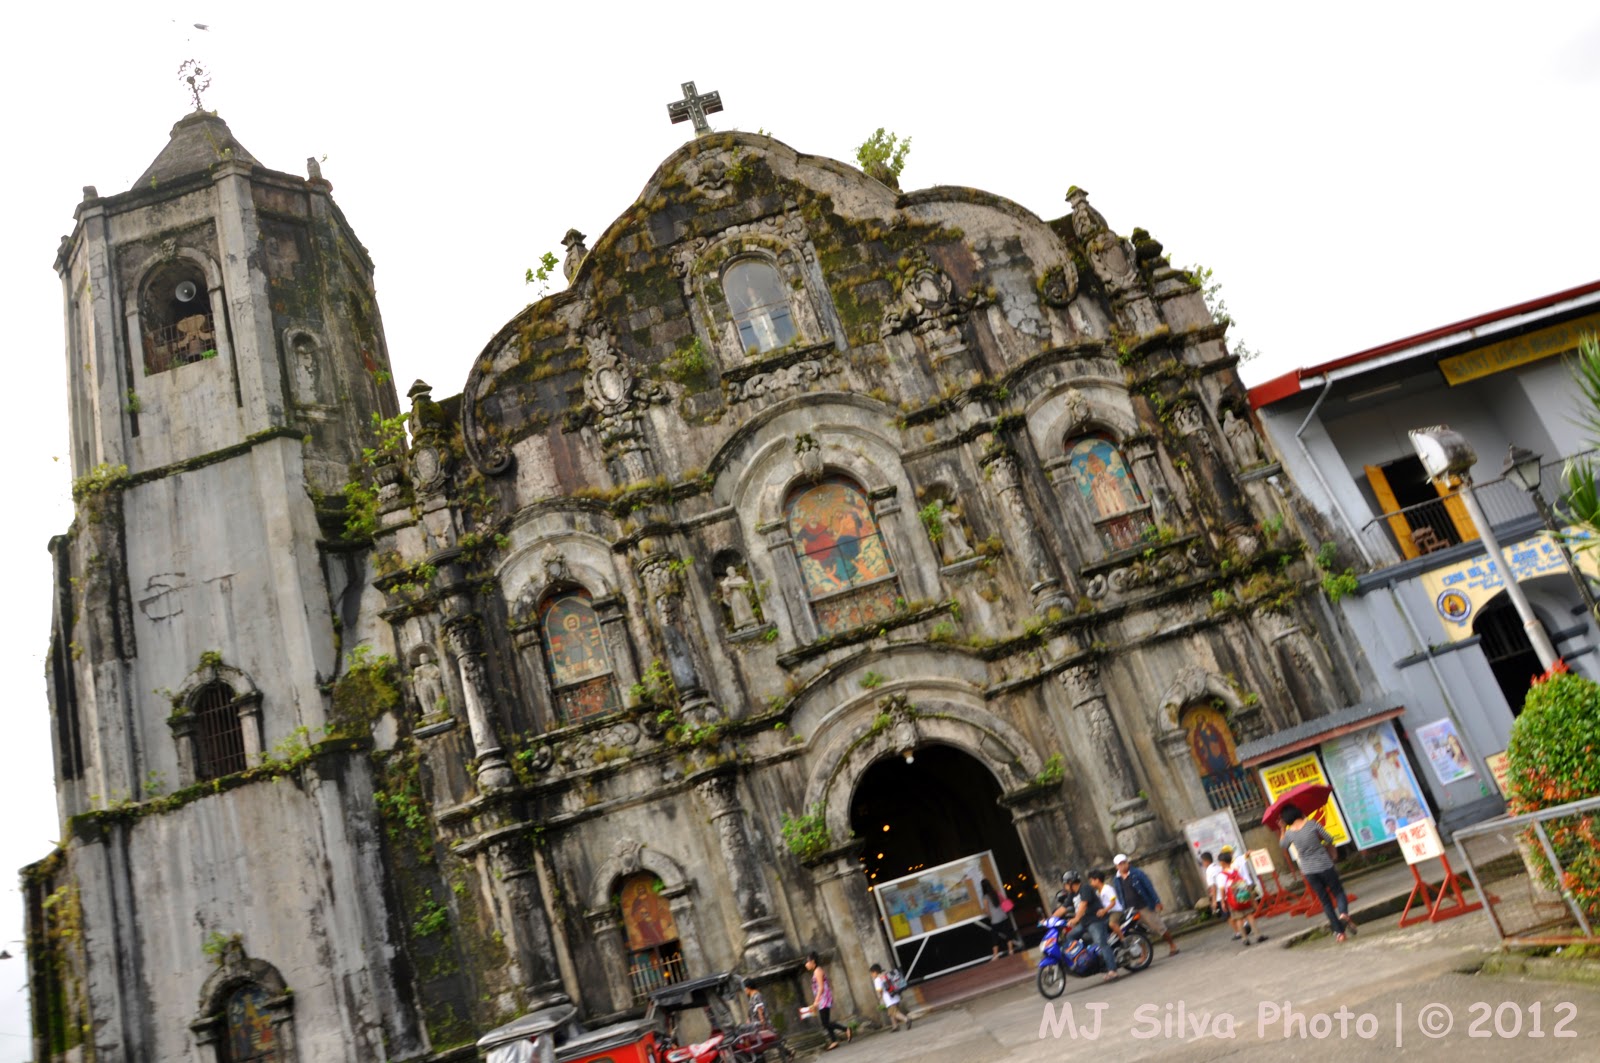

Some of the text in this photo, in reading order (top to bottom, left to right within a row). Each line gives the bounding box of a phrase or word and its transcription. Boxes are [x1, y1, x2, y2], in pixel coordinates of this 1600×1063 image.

[1269, 773, 1287, 789] YEAR
[1287, 769, 1297, 784] OF
[1296, 763, 1319, 780] FAITH
